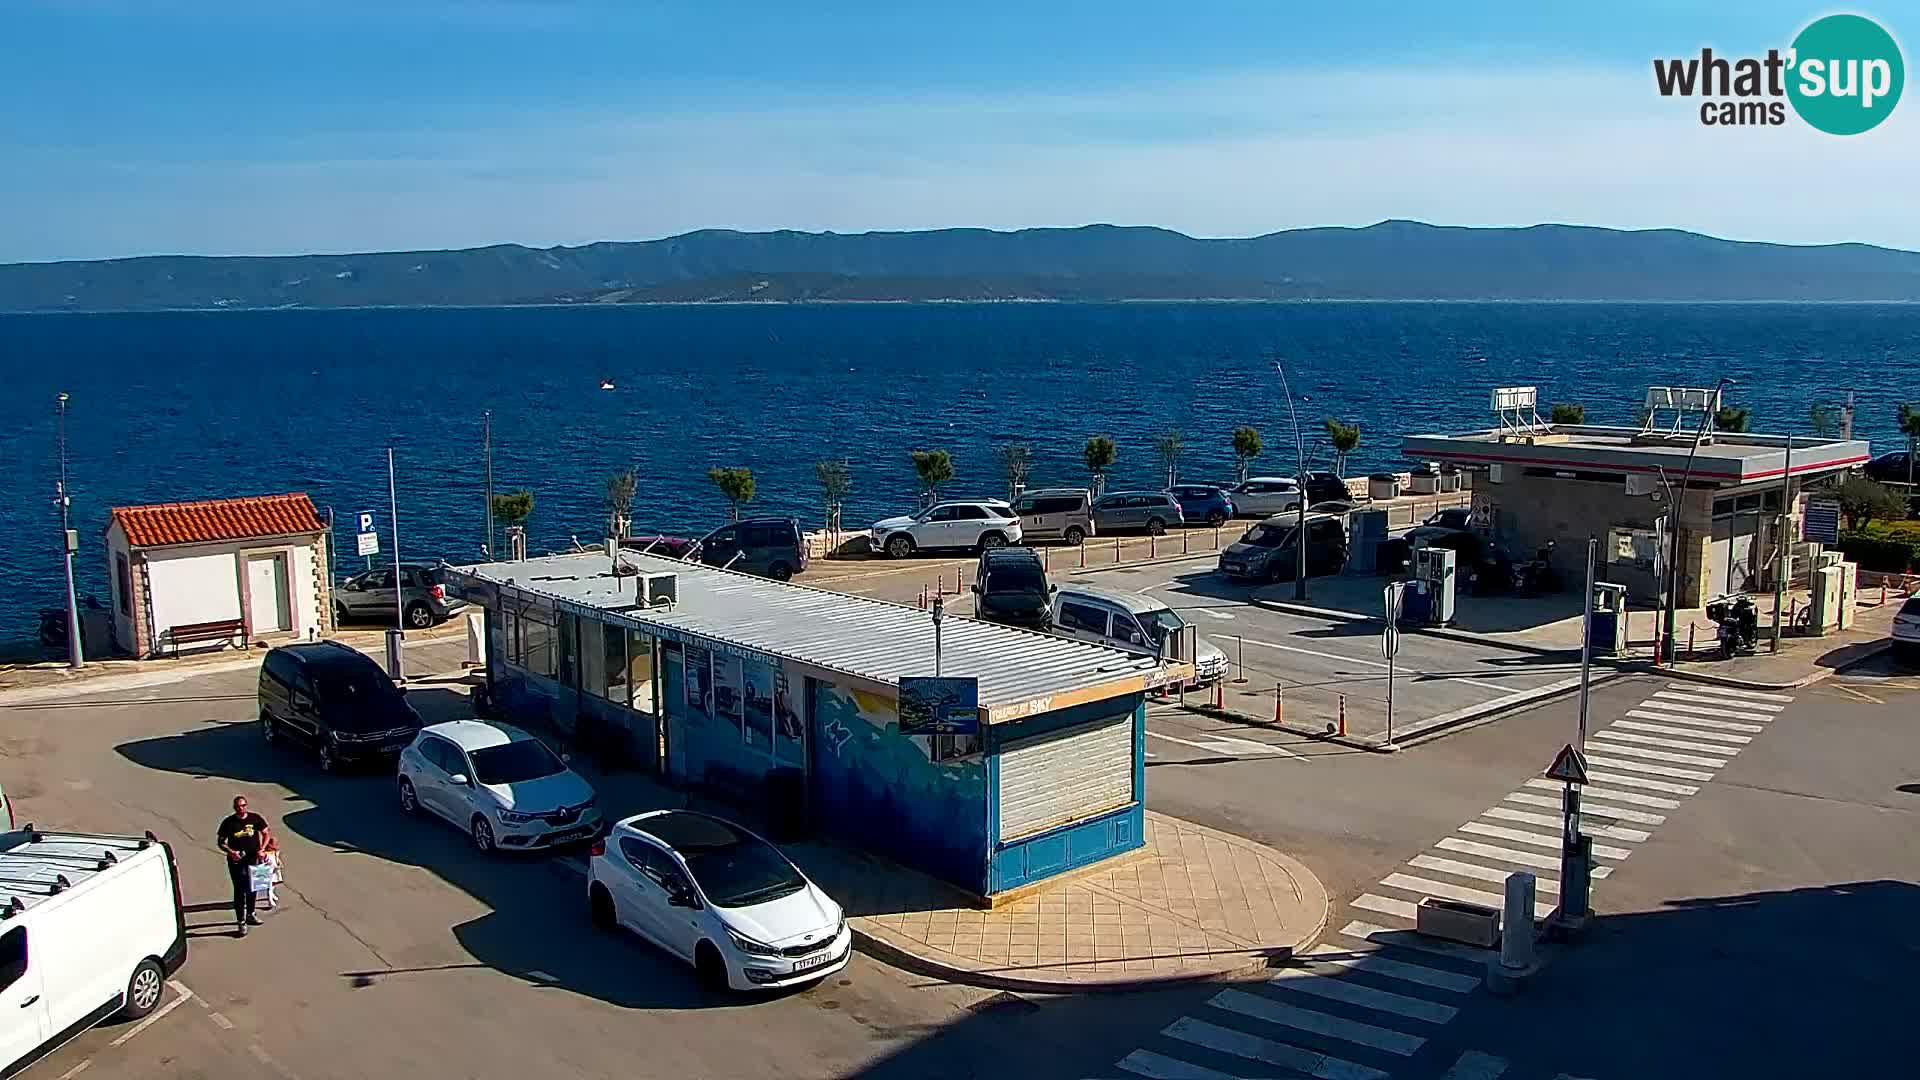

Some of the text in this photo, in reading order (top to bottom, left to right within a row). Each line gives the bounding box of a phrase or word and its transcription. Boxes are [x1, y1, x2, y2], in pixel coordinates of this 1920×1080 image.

[360, 514, 373, 531] P
[694, 638, 725, 651] STATION
[727, 646, 751, 660] TICKET
[752, 653, 779, 666] OFFICE
